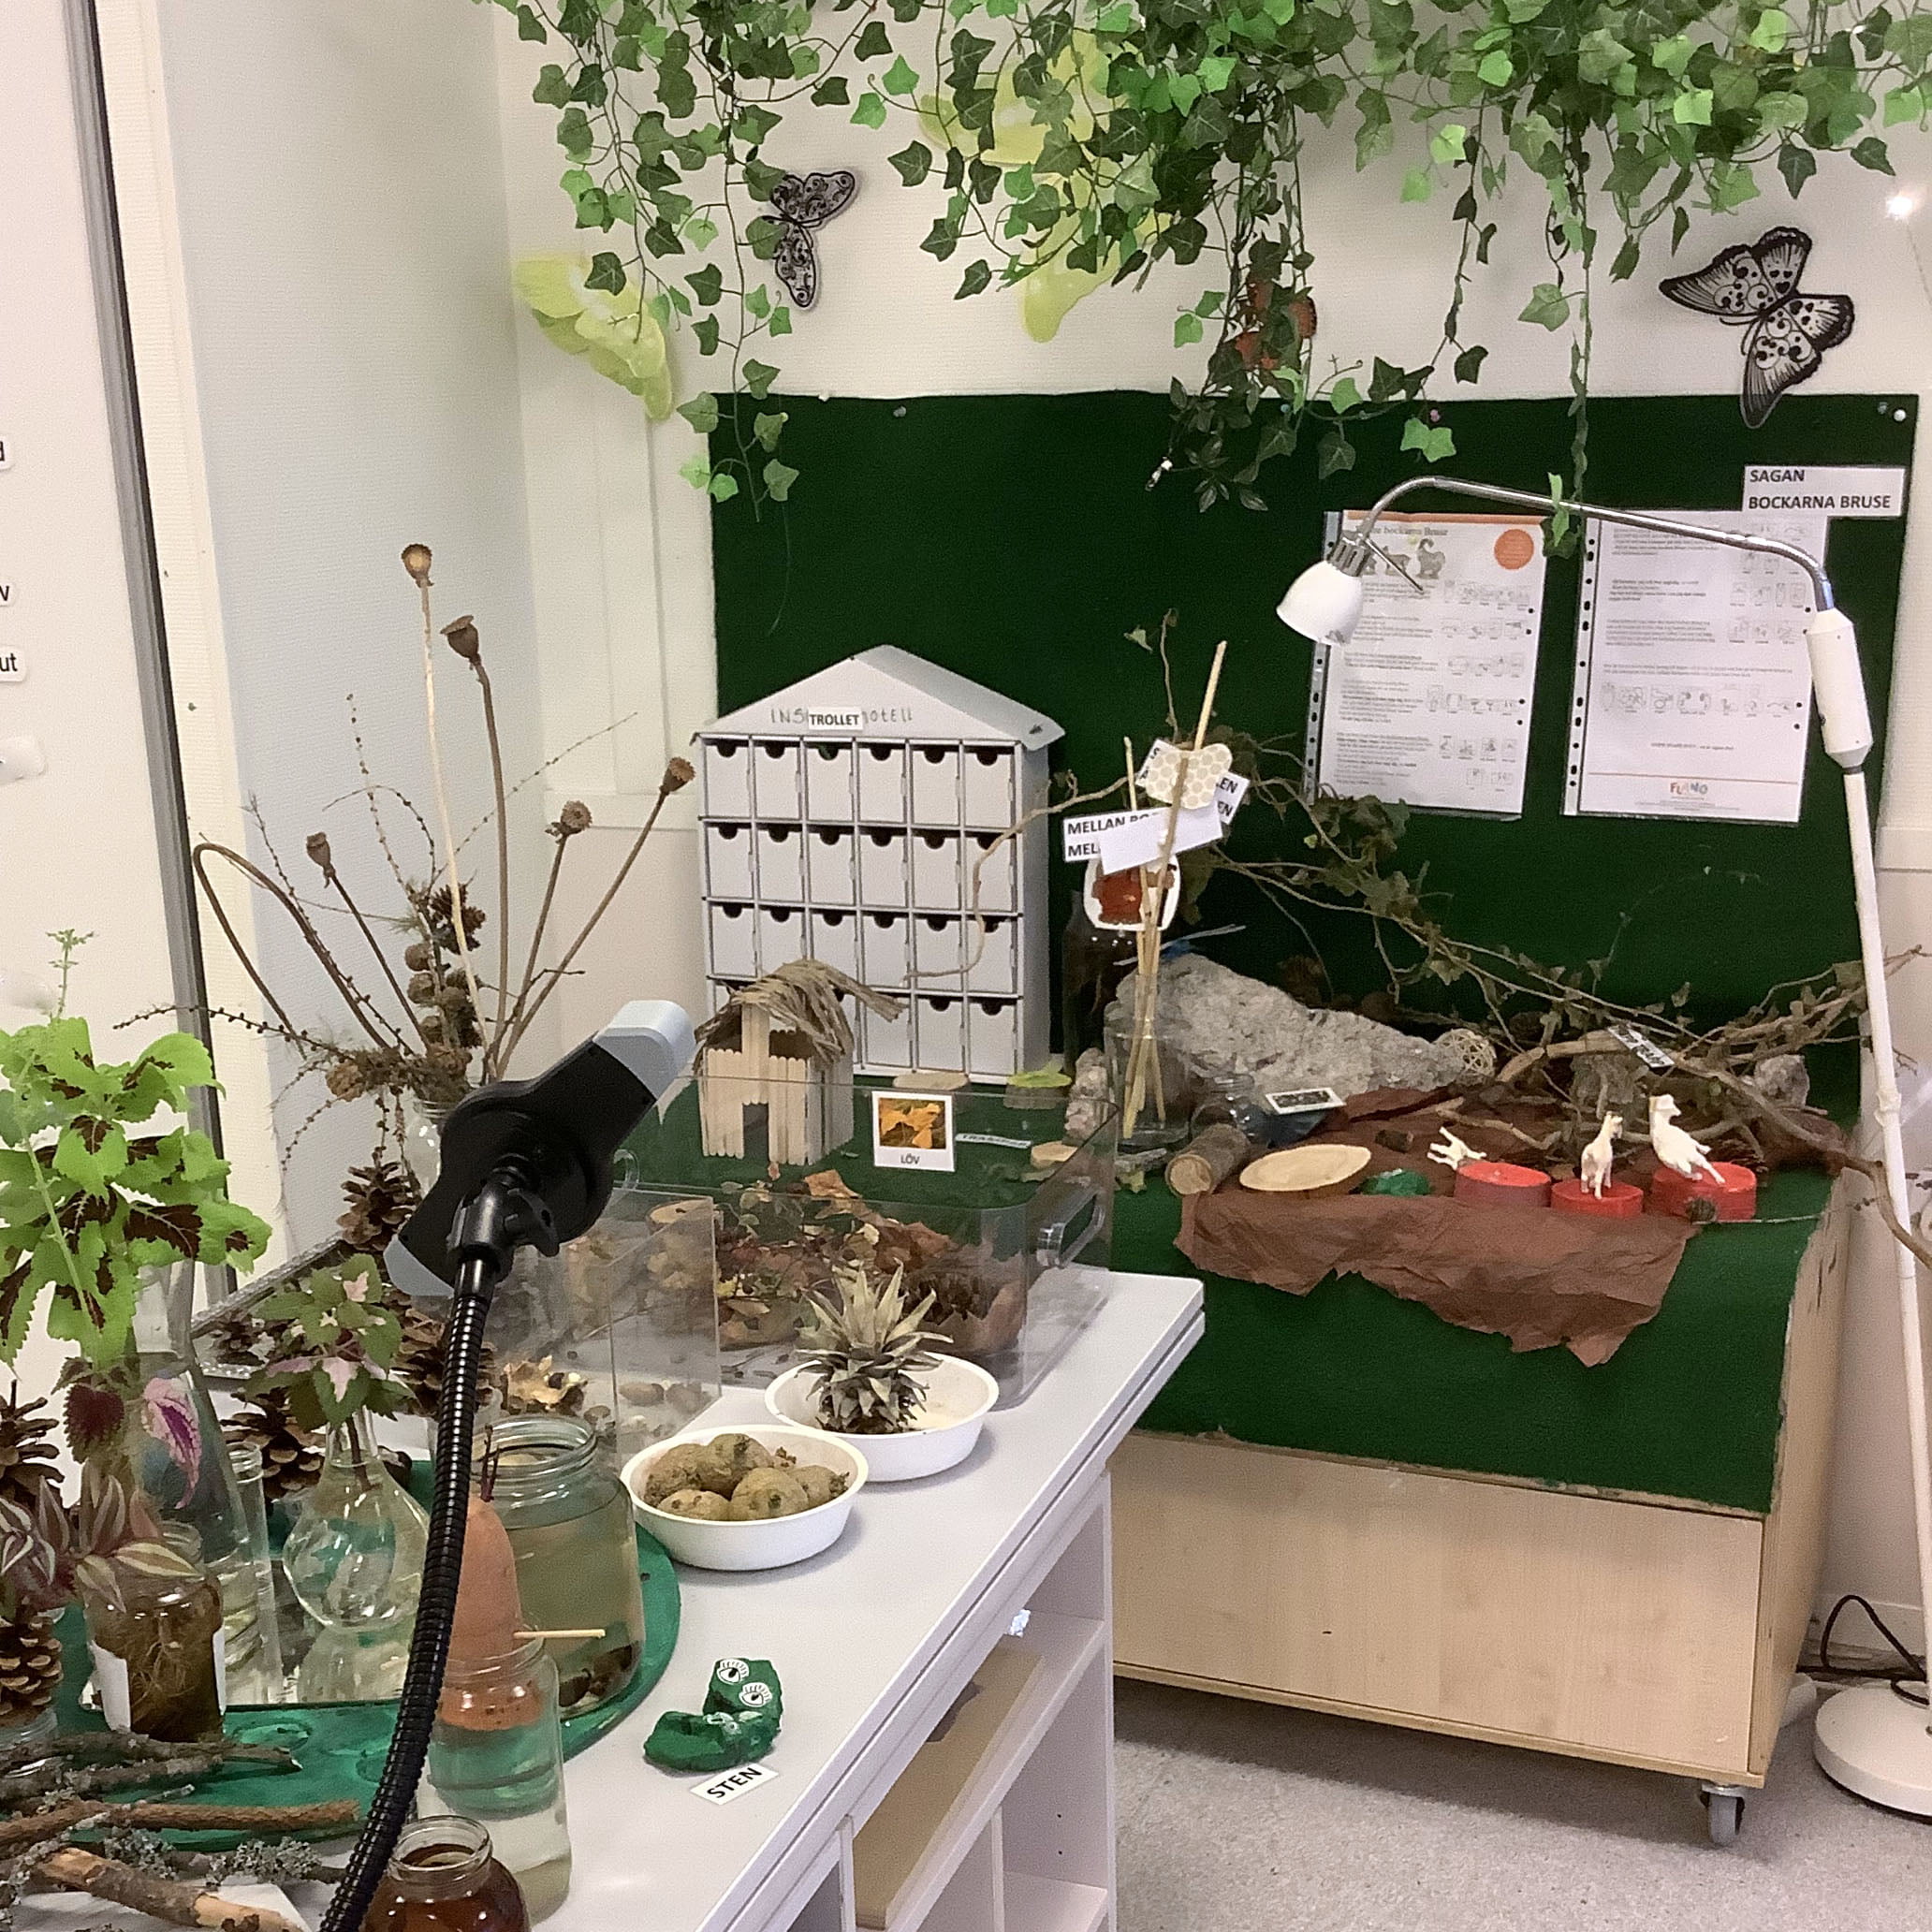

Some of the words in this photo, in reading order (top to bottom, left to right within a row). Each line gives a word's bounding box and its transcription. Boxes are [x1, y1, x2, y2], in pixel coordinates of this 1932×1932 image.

[1749, 469, 1805, 482] SAGAN
[1749, 496, 1835, 509] BOCKARNA
[1840, 495, 1891, 508] BRUSE
[810, 714, 859, 725] TROLLET
[1068, 816, 1125, 834] MELLAN
[1068, 842, 1101, 856] MEL
[900, 1153, 920, 1164] LÖV
[707, 1767, 763, 1798] STEN
